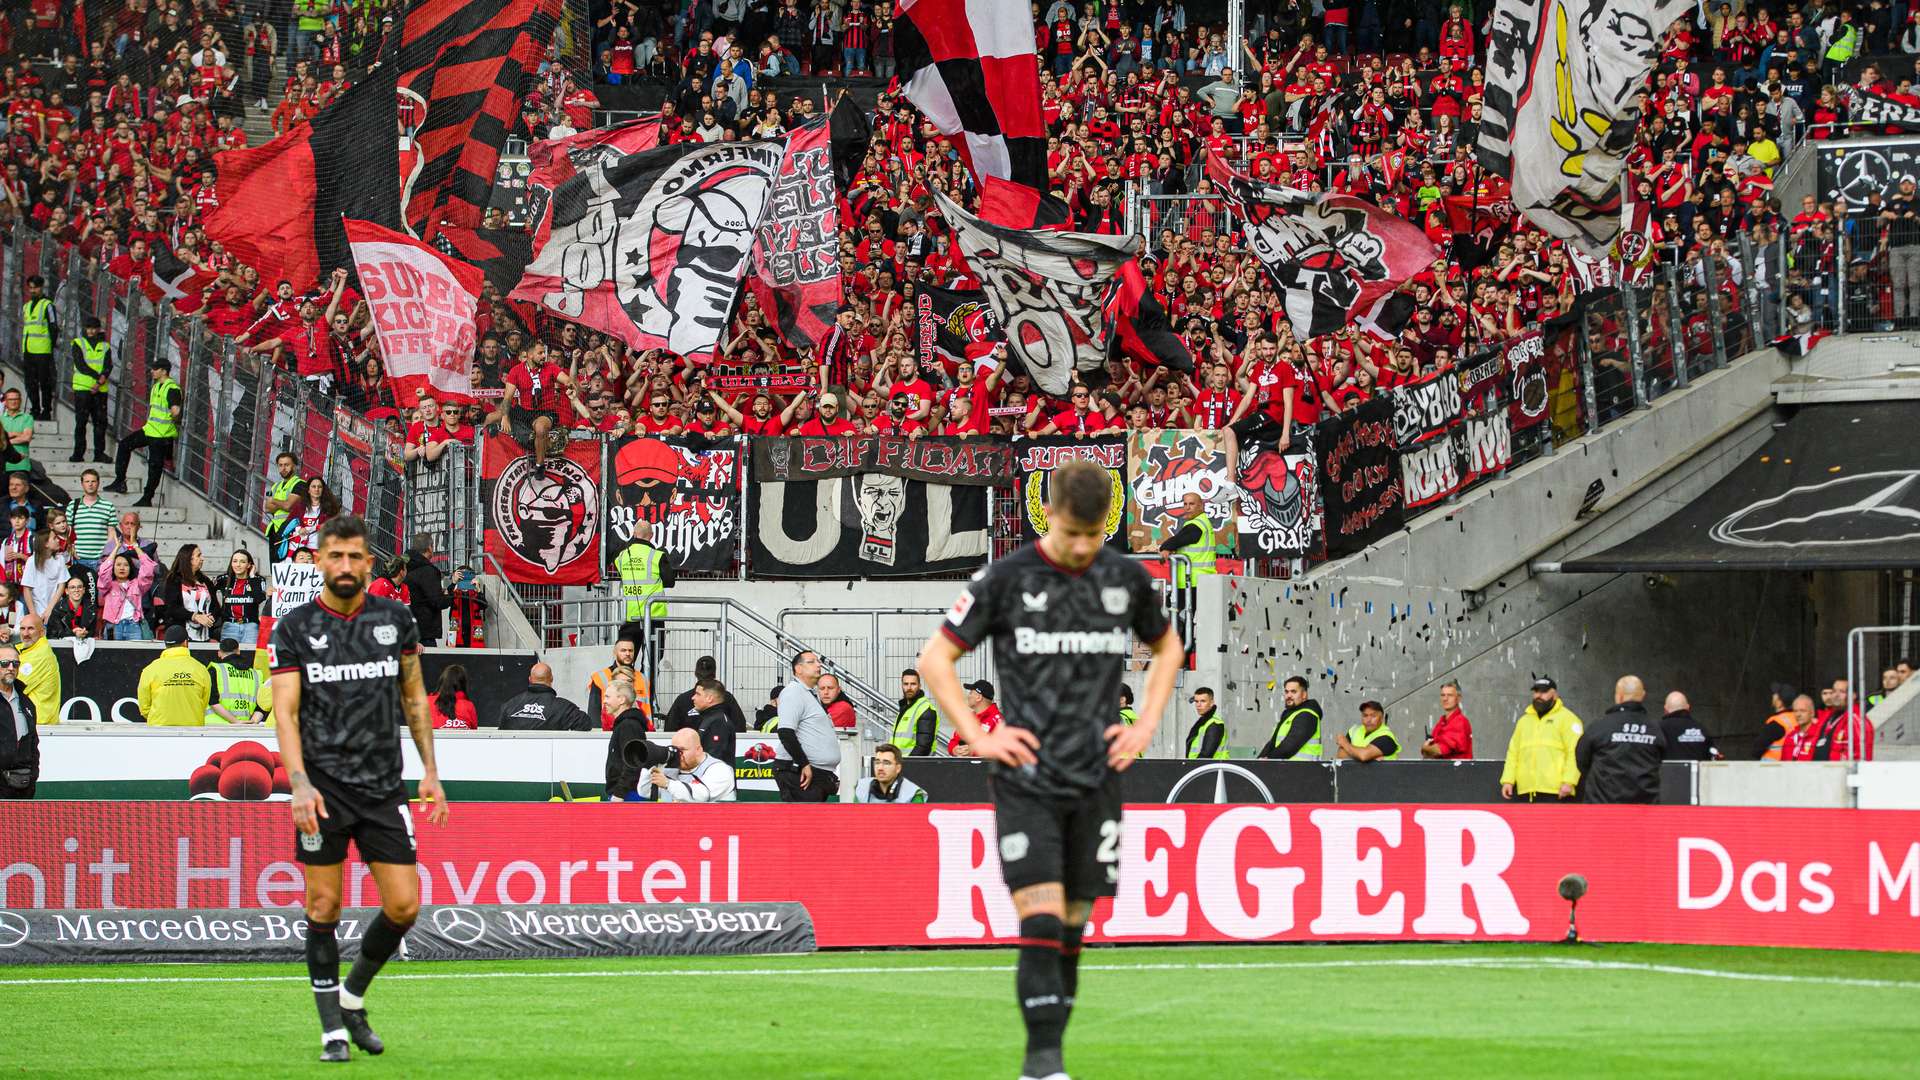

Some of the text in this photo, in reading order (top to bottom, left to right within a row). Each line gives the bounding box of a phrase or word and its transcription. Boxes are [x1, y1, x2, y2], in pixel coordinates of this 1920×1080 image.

[610, 504, 734, 567] Bothers
[276, 589, 306, 604] Kann
[307, 655, 399, 684] Barmeni
[523, 703, 545, 714] SDS
[1611, 732, 1657, 744] SECURITY
[1096, 819, 1122, 863] 2
[176, 834, 740, 910] Hemvorteil
[925, 805, 1530, 940] REGER
[1676, 837, 1836, 914] Das
[56, 914, 362, 942] Mercedes-Bez
[502, 907, 783, 937] Mercedes-Benz
